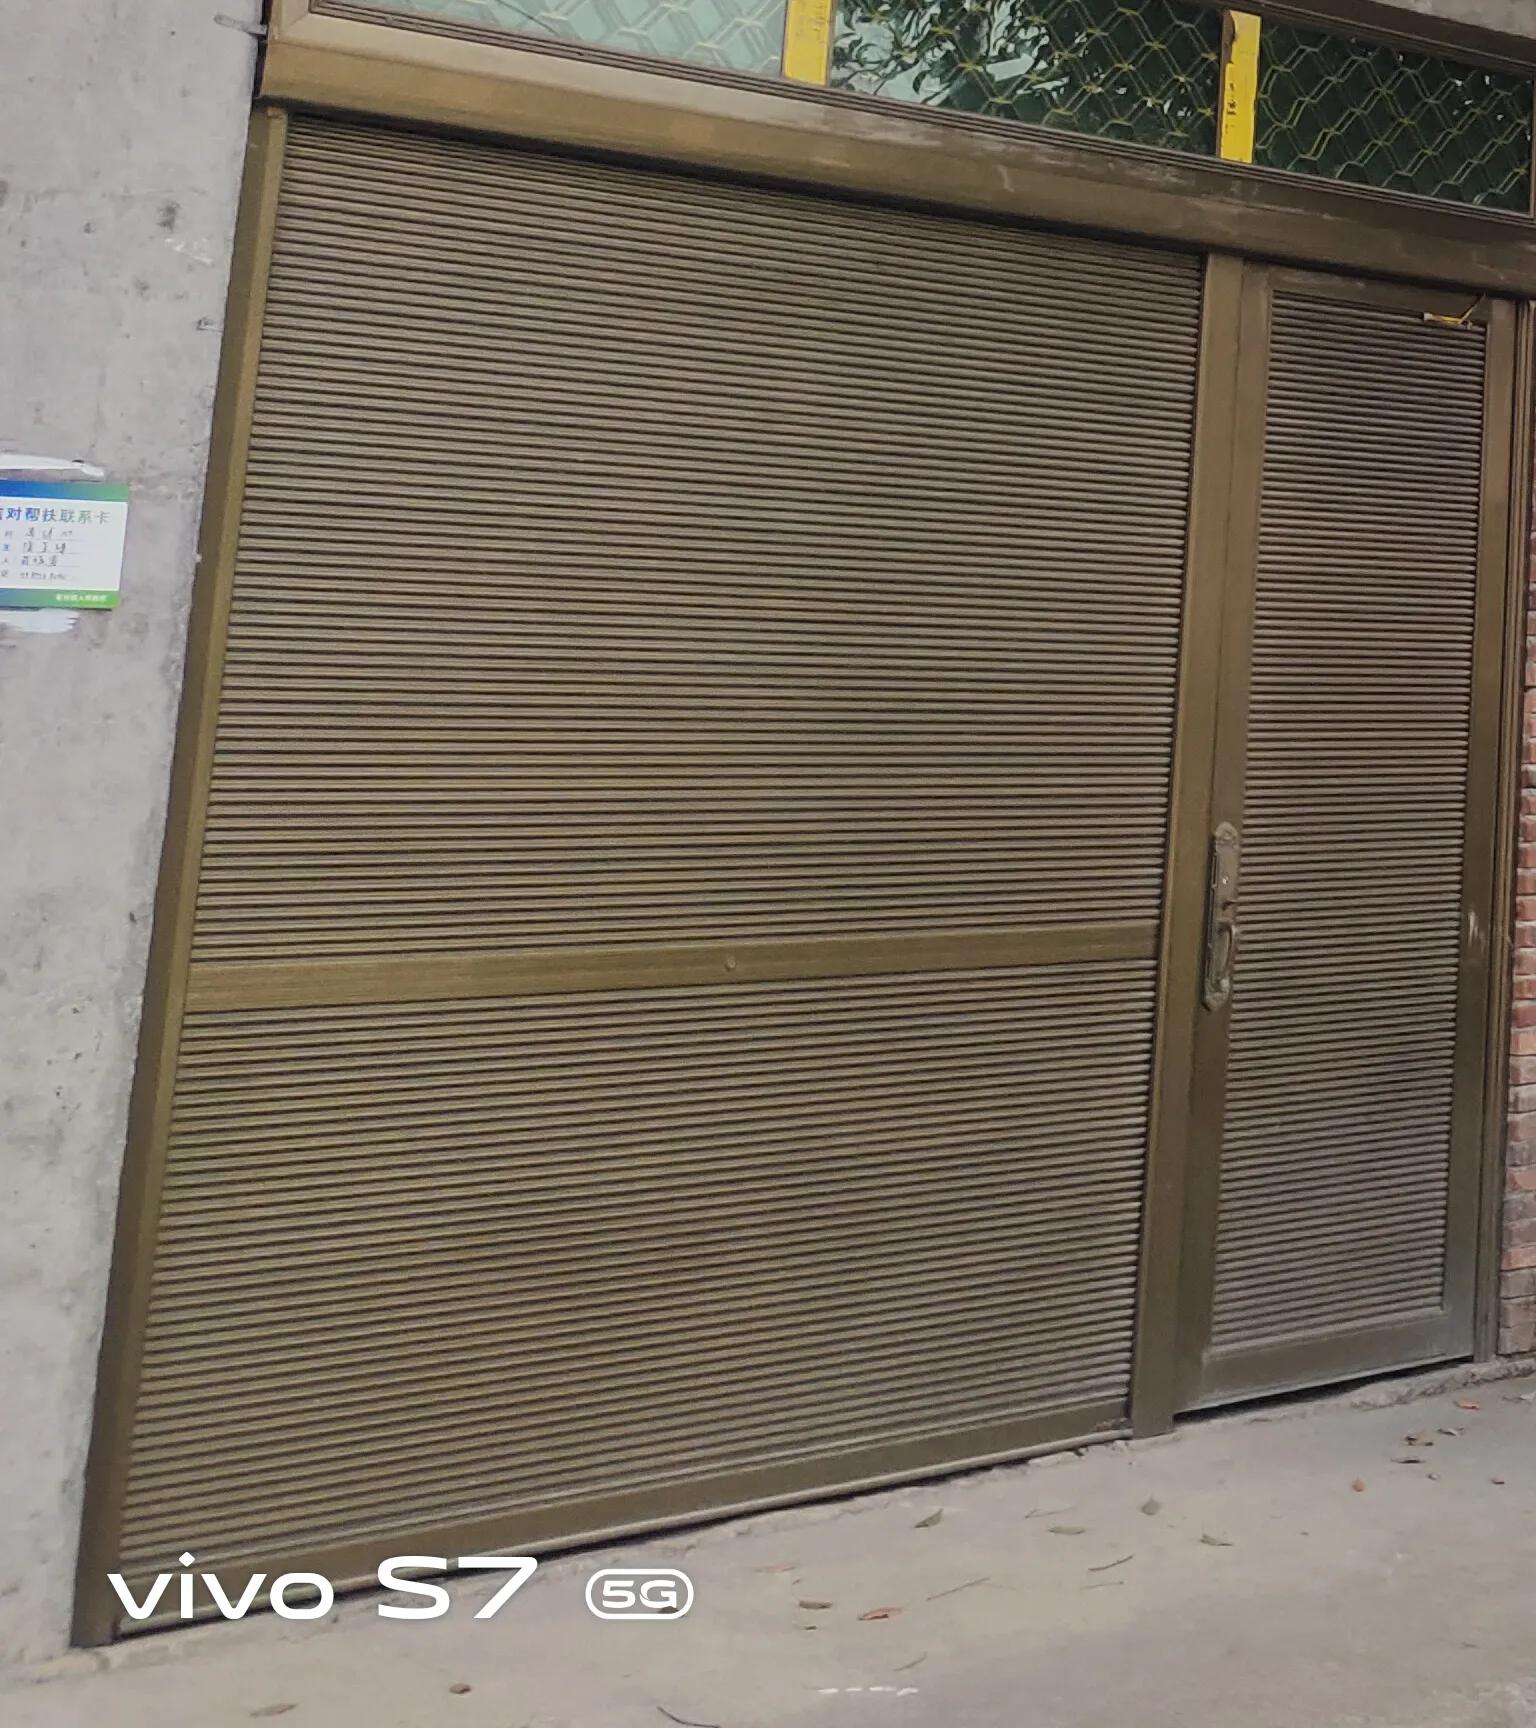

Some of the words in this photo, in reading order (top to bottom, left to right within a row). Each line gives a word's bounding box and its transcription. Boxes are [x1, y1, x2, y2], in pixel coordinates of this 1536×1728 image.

[0, 507, 110, 524] 对帮扶联系卡
